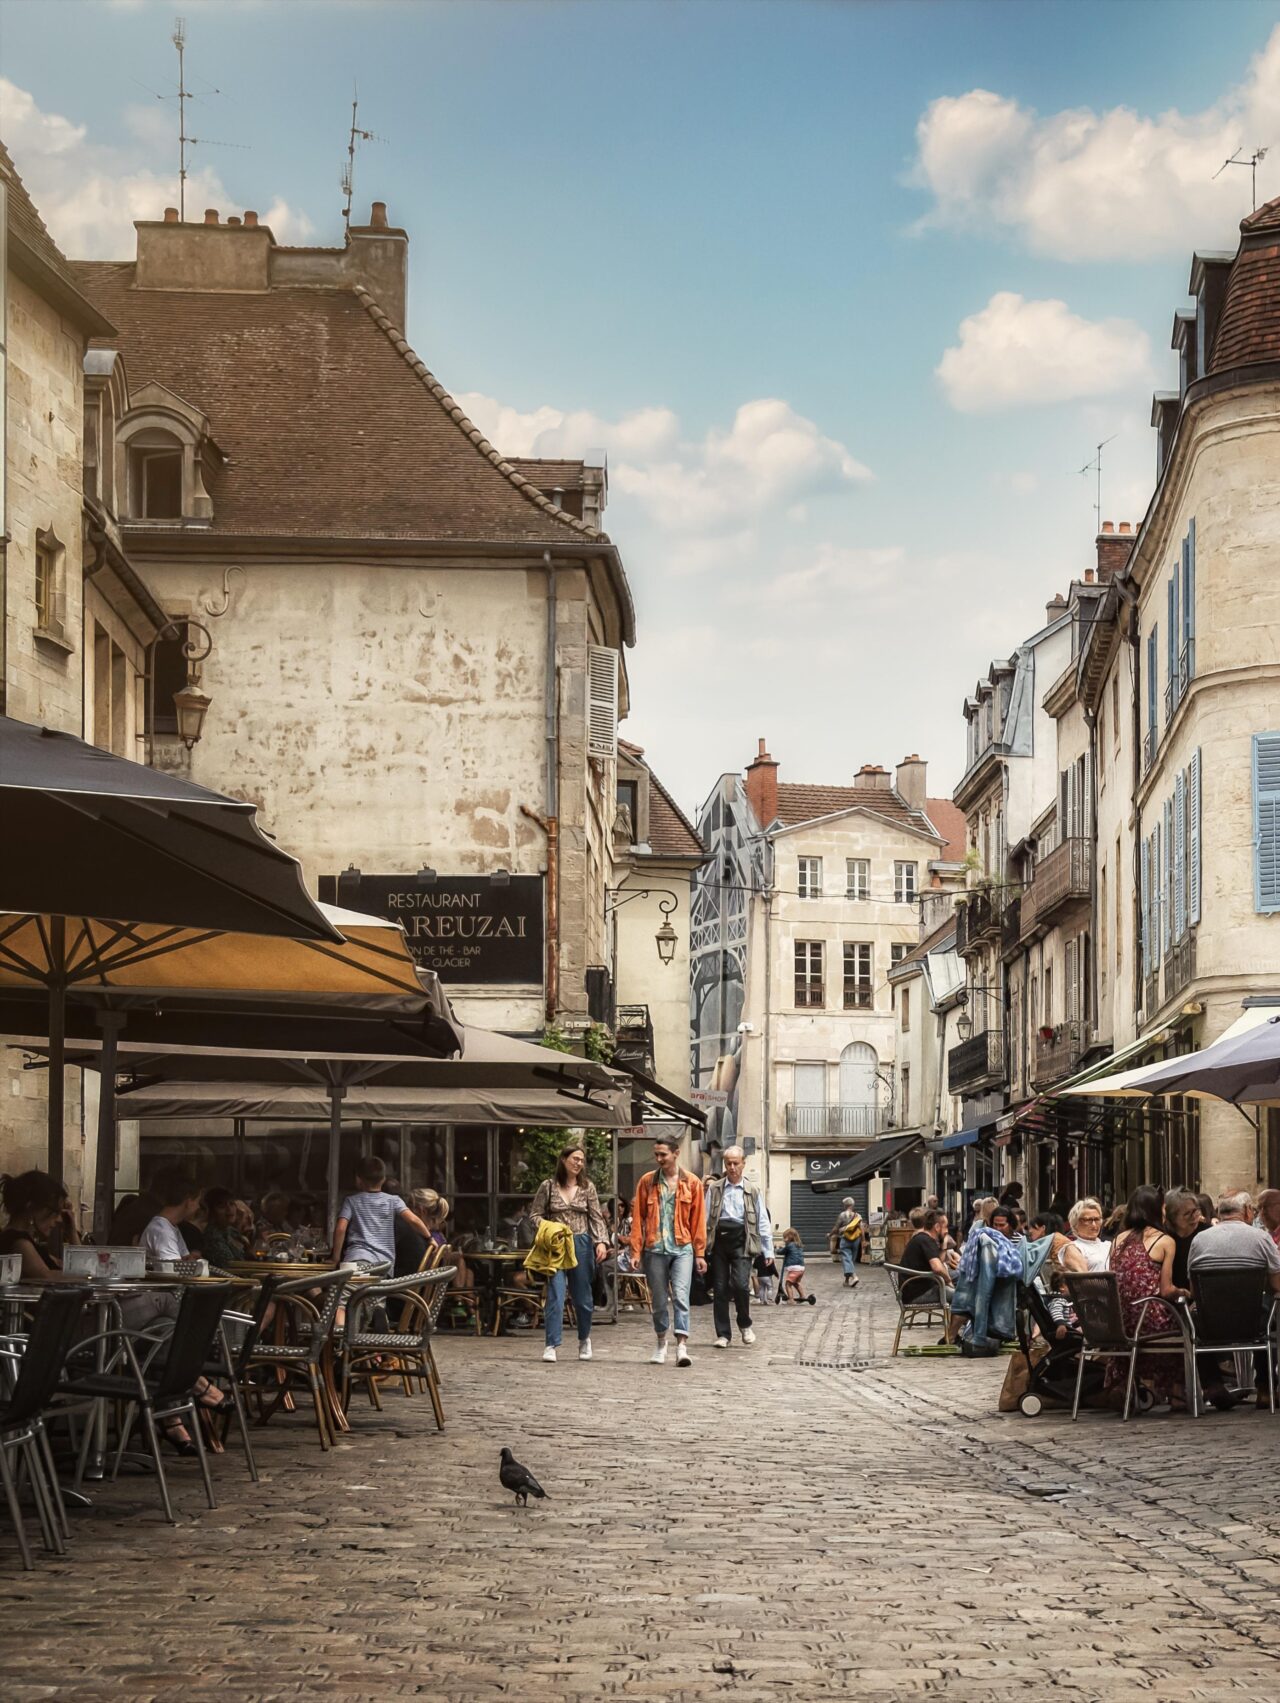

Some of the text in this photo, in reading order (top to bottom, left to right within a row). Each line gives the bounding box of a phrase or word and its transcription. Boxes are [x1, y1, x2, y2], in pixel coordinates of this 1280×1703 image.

[388, 893, 481, 908] RESTAURANT
[379, 915, 527, 938] AREUZAI
[423, 945, 435, 956] DE
[463, 945, 481, 956] BAR
[432, 957, 471, 968] GLACIER
[690, 1092, 705, 1100] ara
